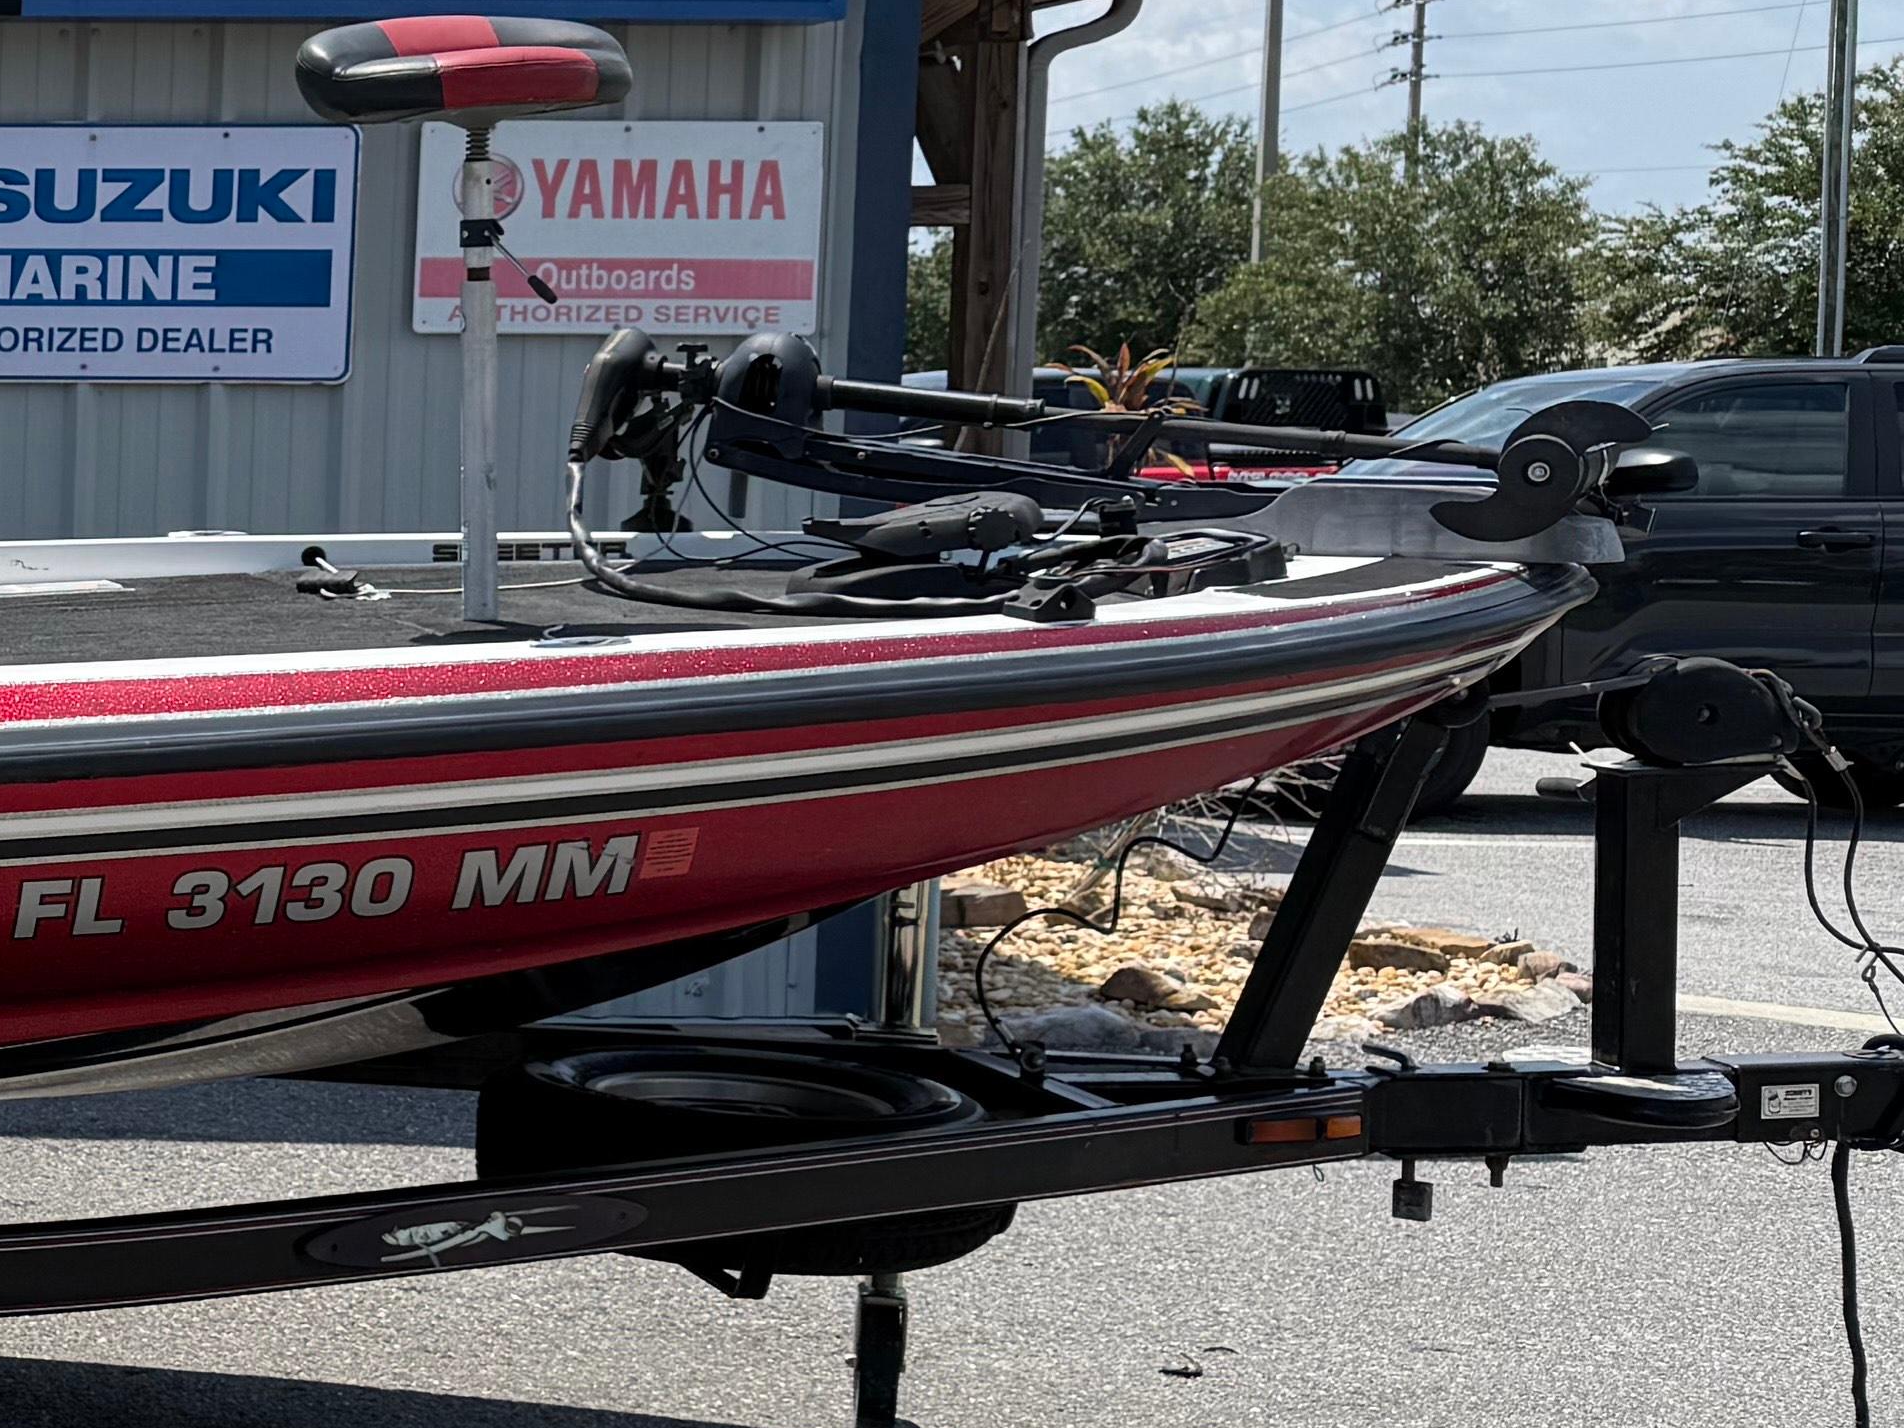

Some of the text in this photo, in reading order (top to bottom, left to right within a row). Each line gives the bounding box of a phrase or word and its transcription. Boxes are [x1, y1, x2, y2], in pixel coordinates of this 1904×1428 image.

[531, 158, 787, 220] YAMAHA
[536, 262, 696, 291] Outboards
[447, 304, 781, 325] ATHORIZED SERVICE
[135, 327, 274, 355] DEALER
[12, 875, 124, 939] FL
[166, 856, 414, 931] 3130
[450, 833, 642, 912] MM
